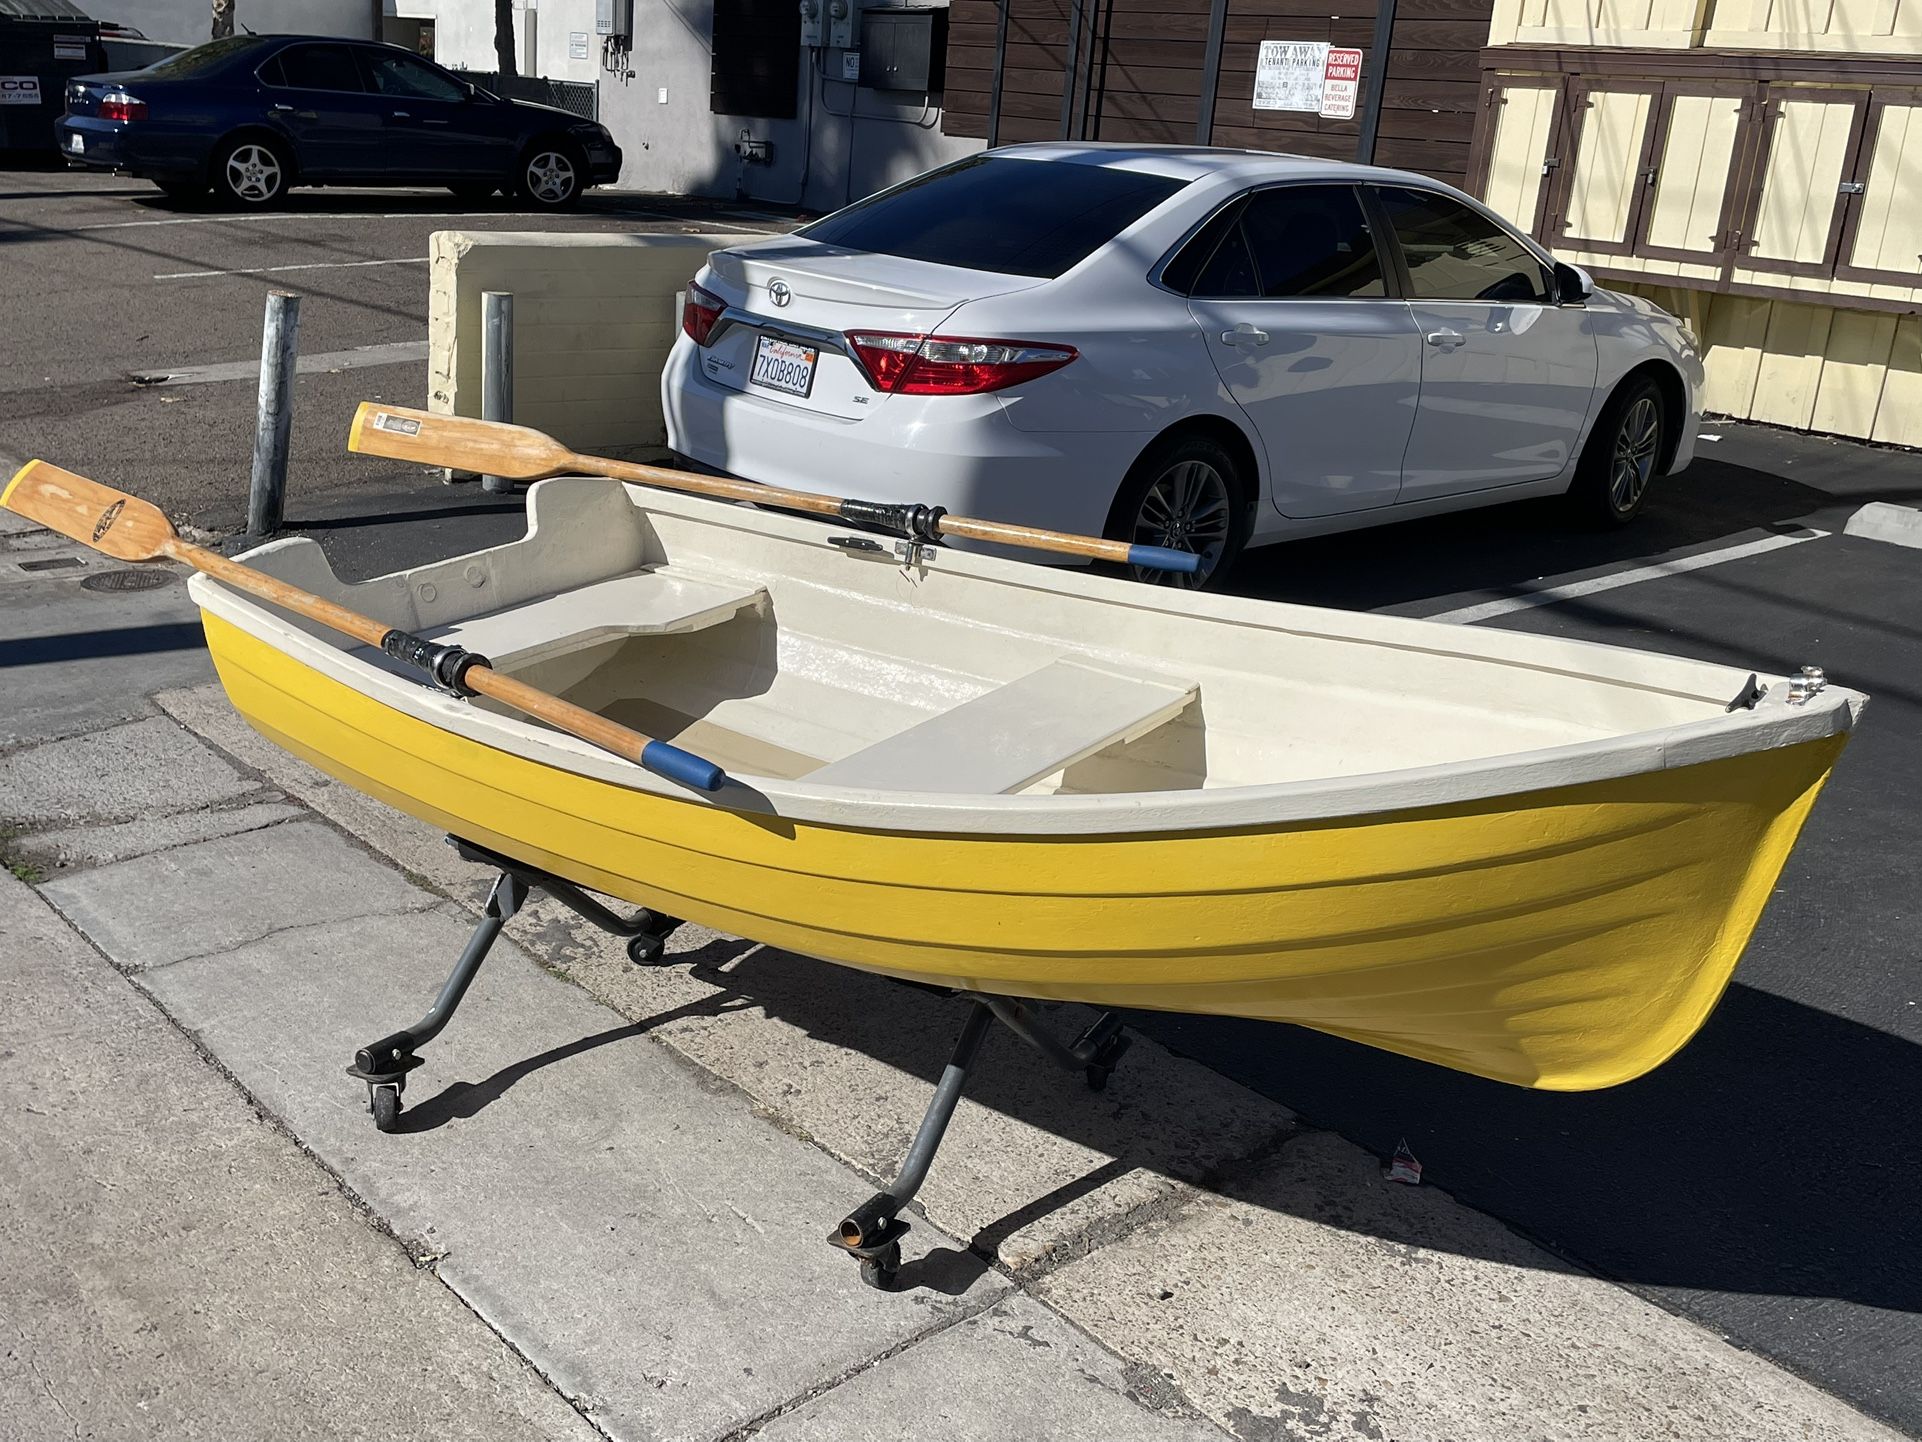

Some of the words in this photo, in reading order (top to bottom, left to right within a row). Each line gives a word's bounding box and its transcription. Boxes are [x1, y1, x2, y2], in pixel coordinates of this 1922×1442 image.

[1264, 46, 1290, 58] TOW
[1293, 46, 1325, 59] AWAY
[1265, 58, 1289, 66] TENANT
[1292, 58, 1320, 67] PARKING
[1328, 53, 1359, 65] RESERVED
[1328, 66, 1356, 79] PARKING
[1331, 84, 1348, 92] BELLA
[1325, 94, 1352, 103] BEVERAGE
[1324, 104, 1349, 112] CATERING
[769, 345, 804, 361] California
[852, 395, 869, 405] SE
